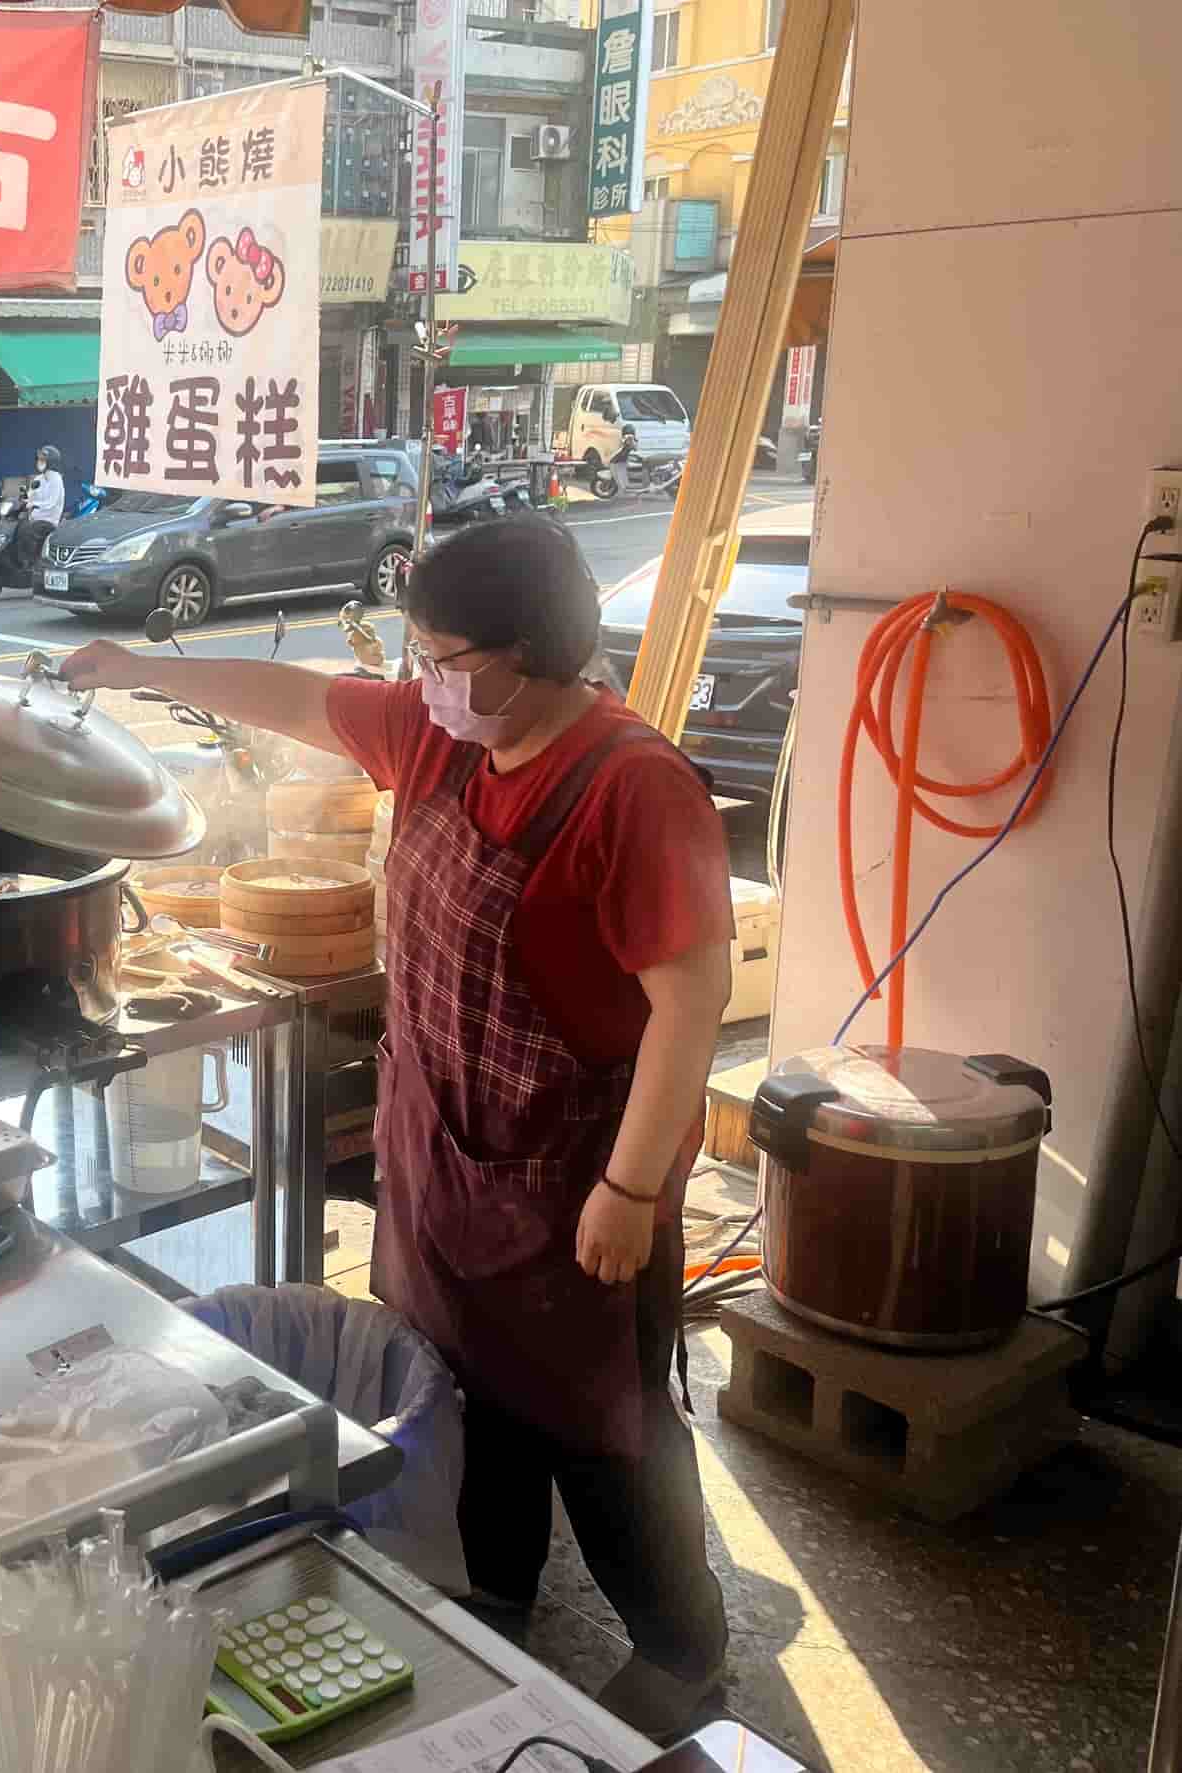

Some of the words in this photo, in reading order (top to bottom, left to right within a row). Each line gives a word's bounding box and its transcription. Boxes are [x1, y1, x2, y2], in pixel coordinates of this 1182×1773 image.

[158, 128, 275, 194] 小熊燒
[102, 374, 302, 489] 雞蛋糕
